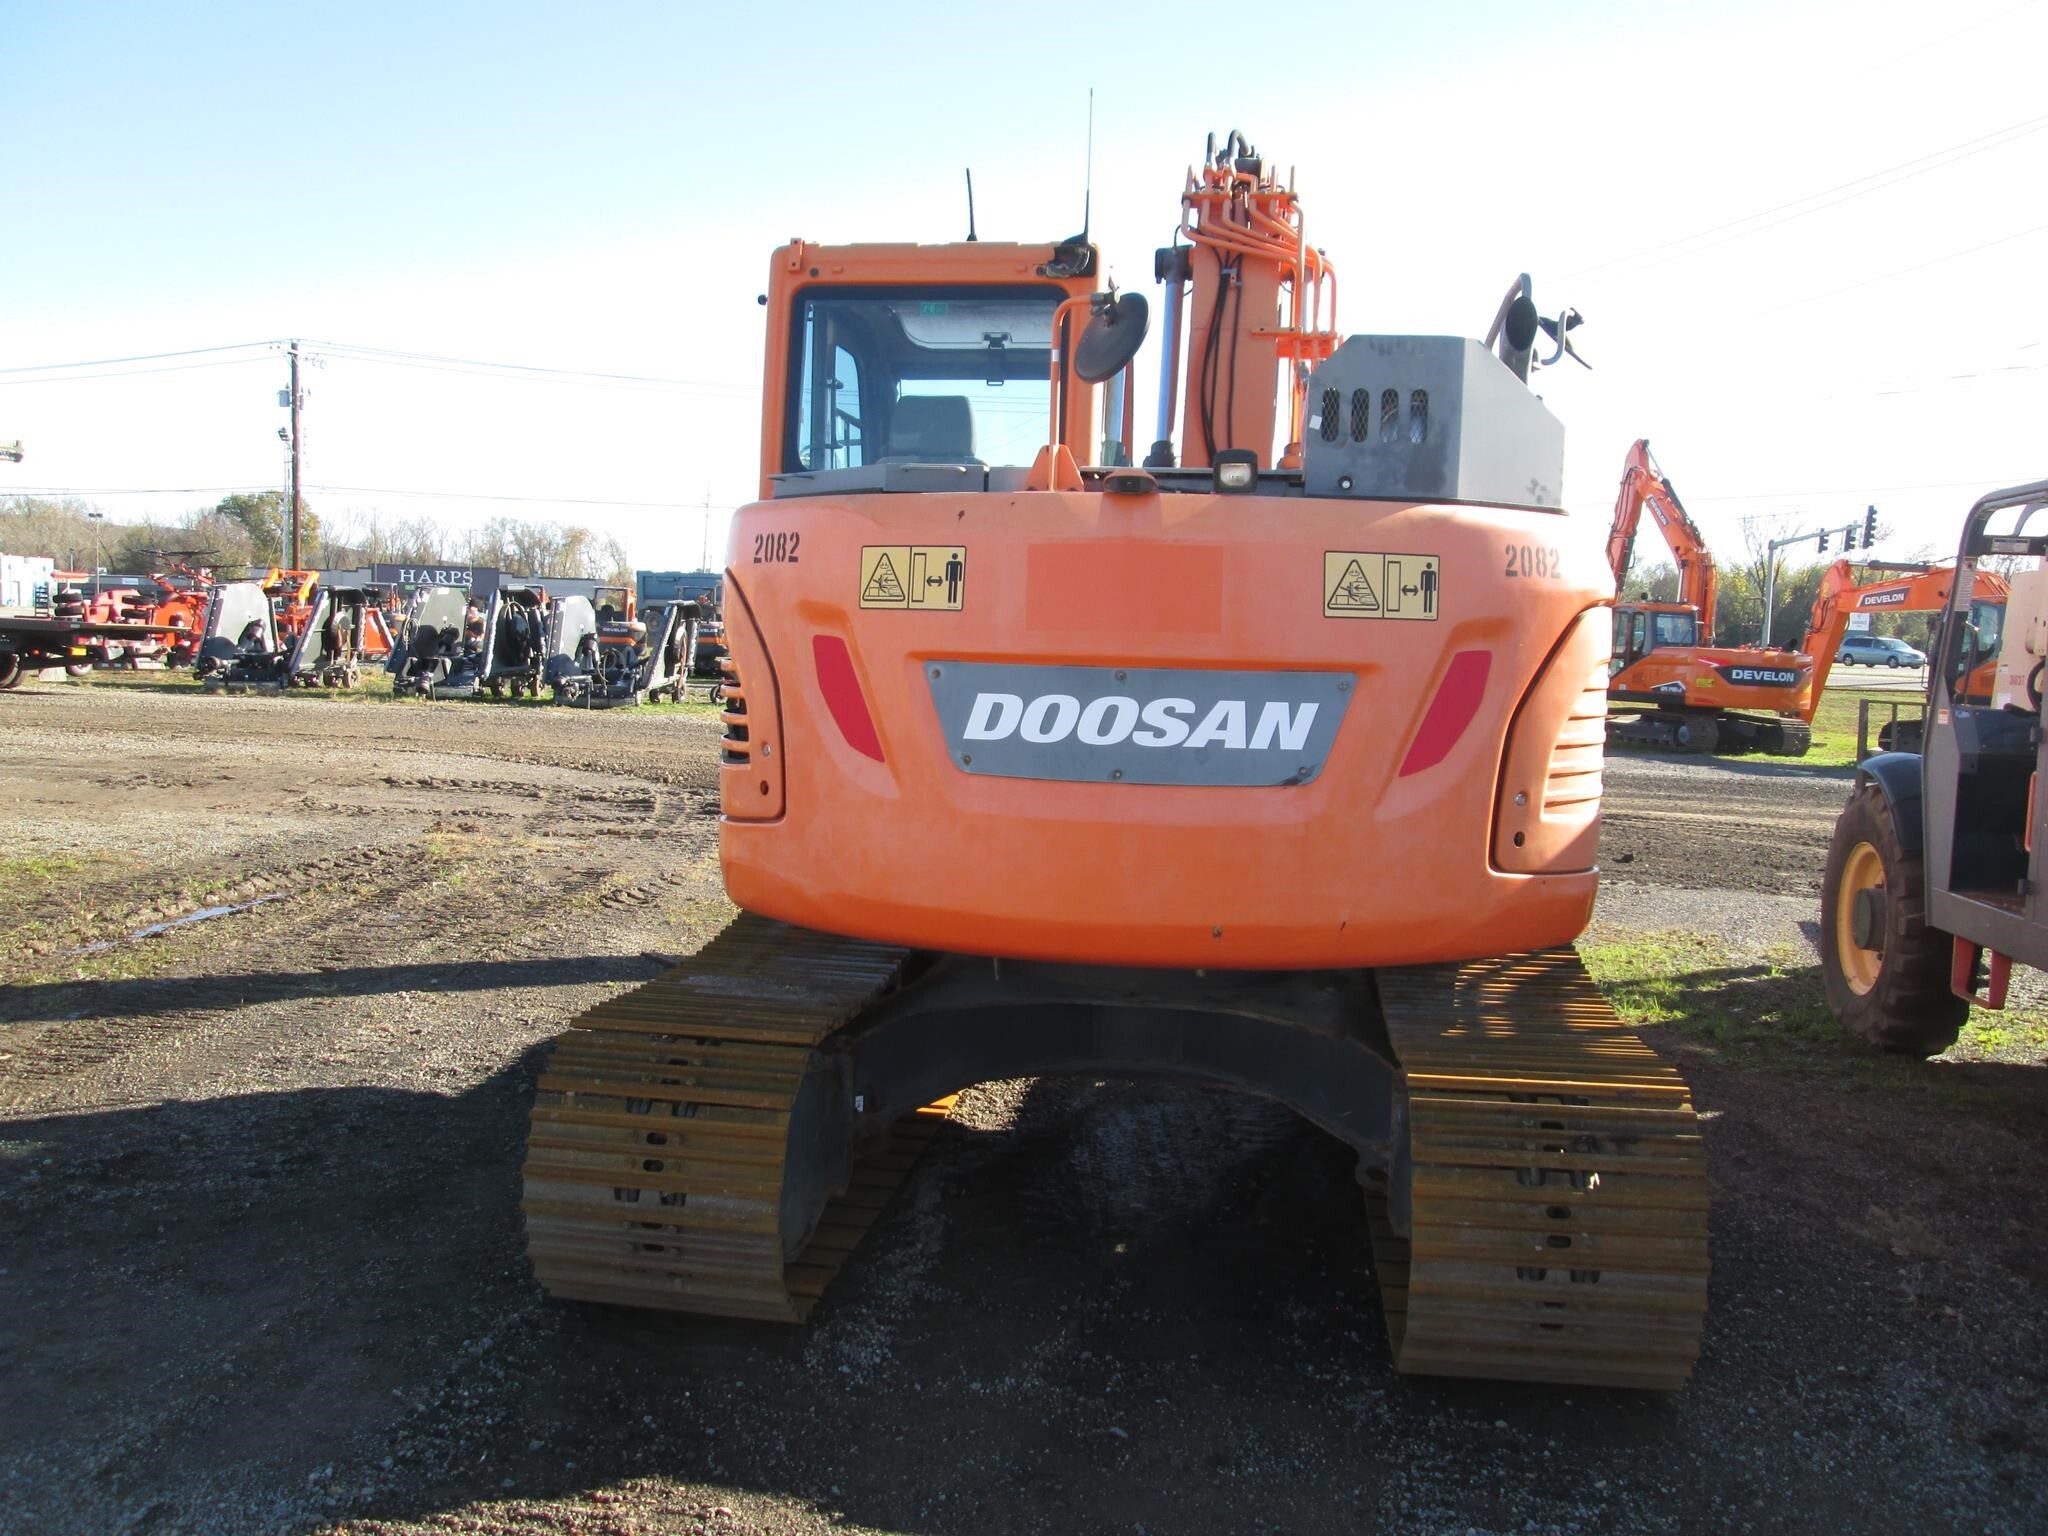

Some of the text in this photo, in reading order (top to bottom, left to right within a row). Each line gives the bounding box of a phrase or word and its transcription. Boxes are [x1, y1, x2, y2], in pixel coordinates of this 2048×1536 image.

[753, 532, 800, 563] 2082
[1505, 544, 1562, 579] 2082
[399, 569, 473, 584] HARPS
[1864, 593, 1905, 605] DEVELON
[1732, 669, 1795, 682] DEVELON
[963, 692, 1320, 750] DOOSAN
